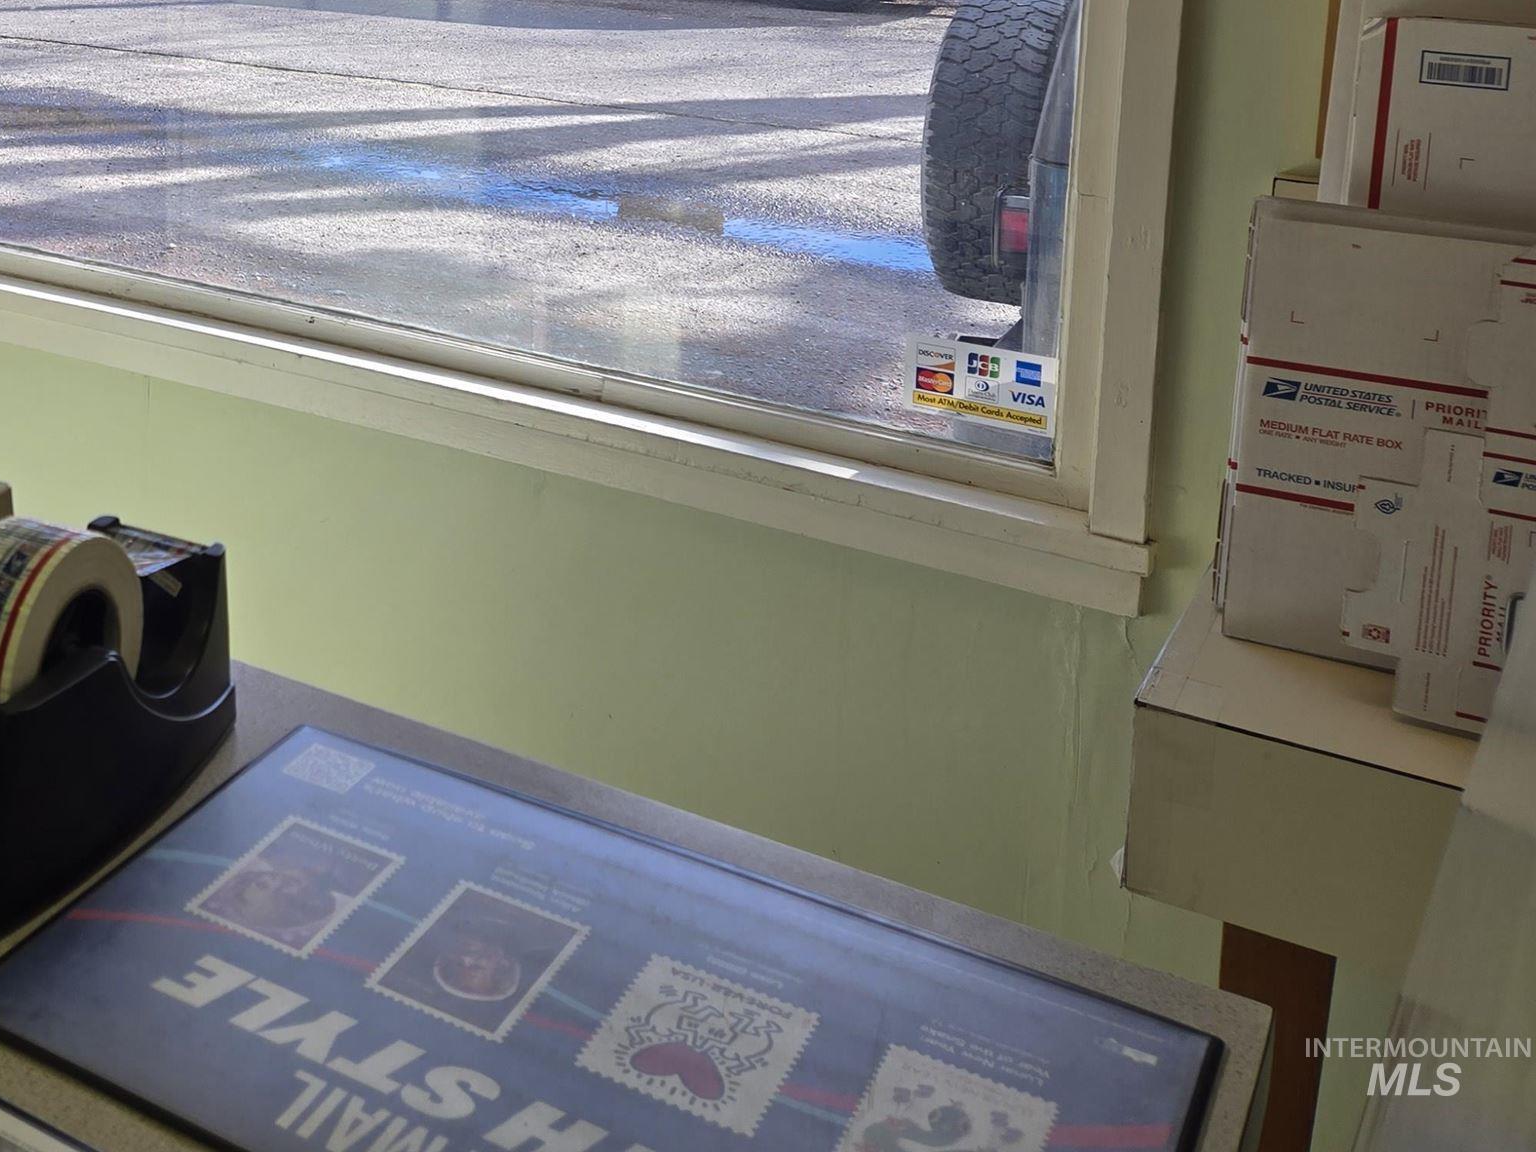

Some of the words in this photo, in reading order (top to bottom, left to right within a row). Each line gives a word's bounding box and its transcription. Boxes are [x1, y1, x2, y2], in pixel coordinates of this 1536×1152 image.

[918, 349, 954, 361] DISCOVER
[1009, 390, 1046, 408] VISA
[1303, 382, 1348, 398] UNITED
[1351, 388, 1393, 404] STATES
[917, 394, 936, 404] Most
[980, 407, 1004, 418] Cards
[1006, 411, 1043, 425] Accepted
[1299, 393, 1343, 409] POSTAL
[1345, 400, 1395, 417] SERVICE
[1425, 401, 1487, 419] PRIORIT
[1442, 415, 1482, 429] MAIL
[1259, 418, 1309, 435] MEDIUM
[1311, 426, 1341, 440] FLAT
[1343, 432, 1373, 446] RATE
[1376, 437, 1403, 450] BOX
[1256, 468, 1312, 485] TRACKED
[1477, 580, 1498, 658] PRIORITY
[151, 953, 502, 1121] STYLE
